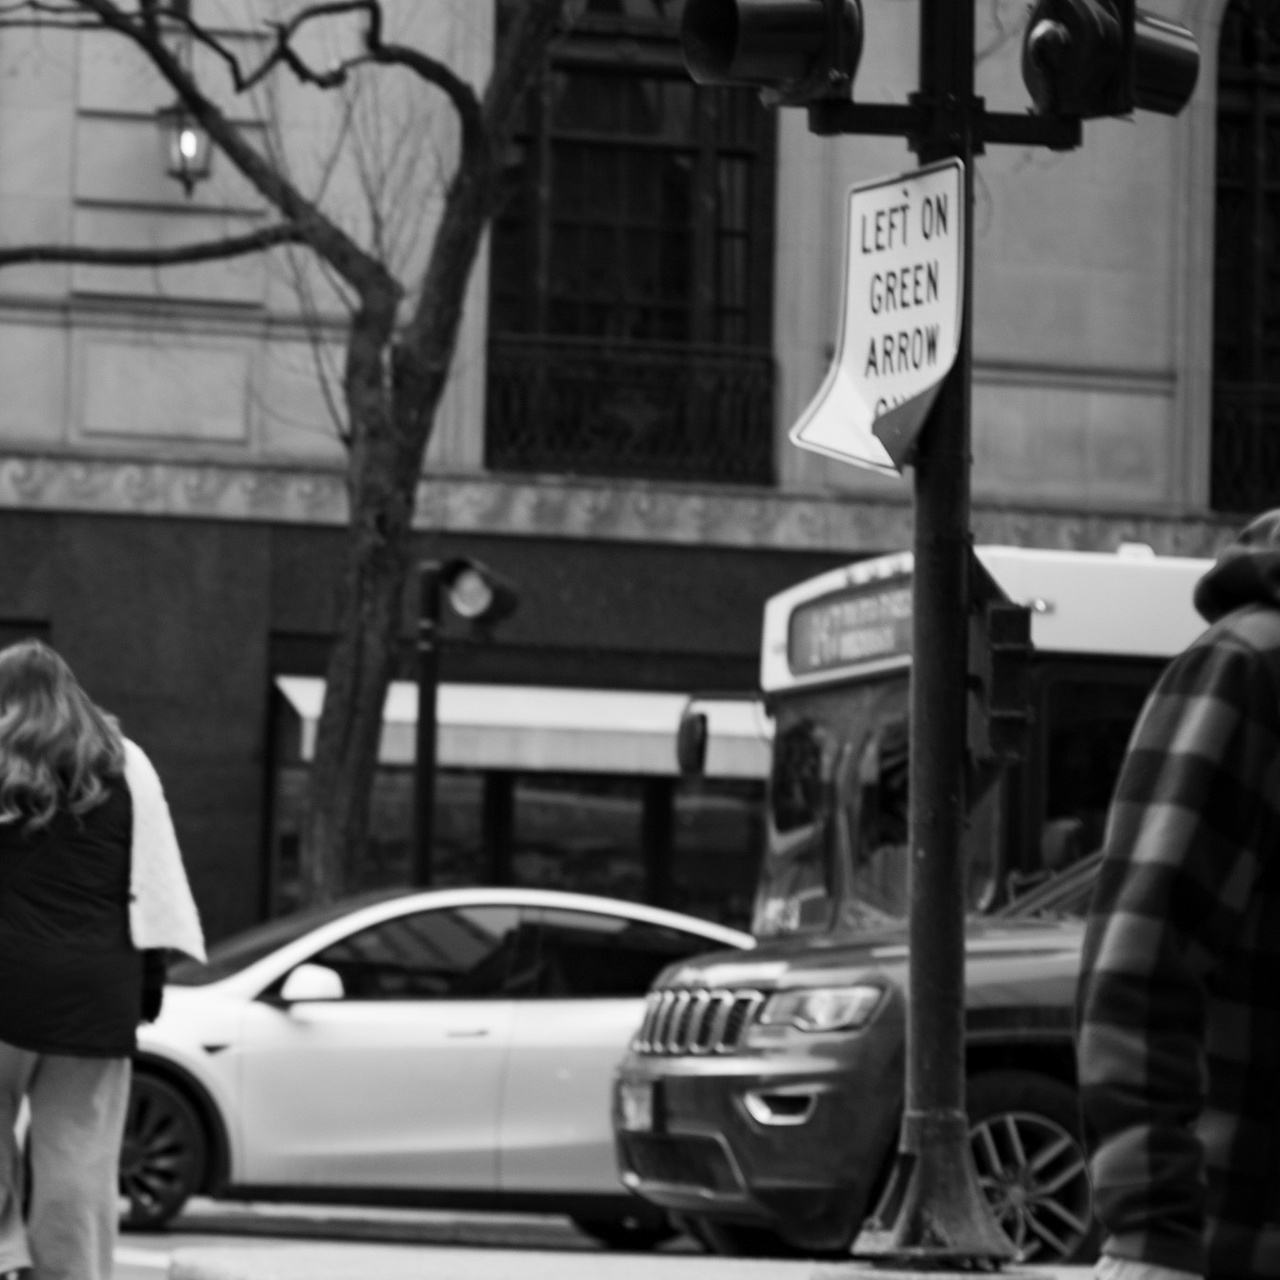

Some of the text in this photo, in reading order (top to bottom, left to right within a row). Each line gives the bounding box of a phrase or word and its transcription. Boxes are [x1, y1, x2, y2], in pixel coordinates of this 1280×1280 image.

[860, 192, 949, 255] LEFT ON
[870, 259, 940, 316] GREEN
[864, 323, 940, 379] ARROW
